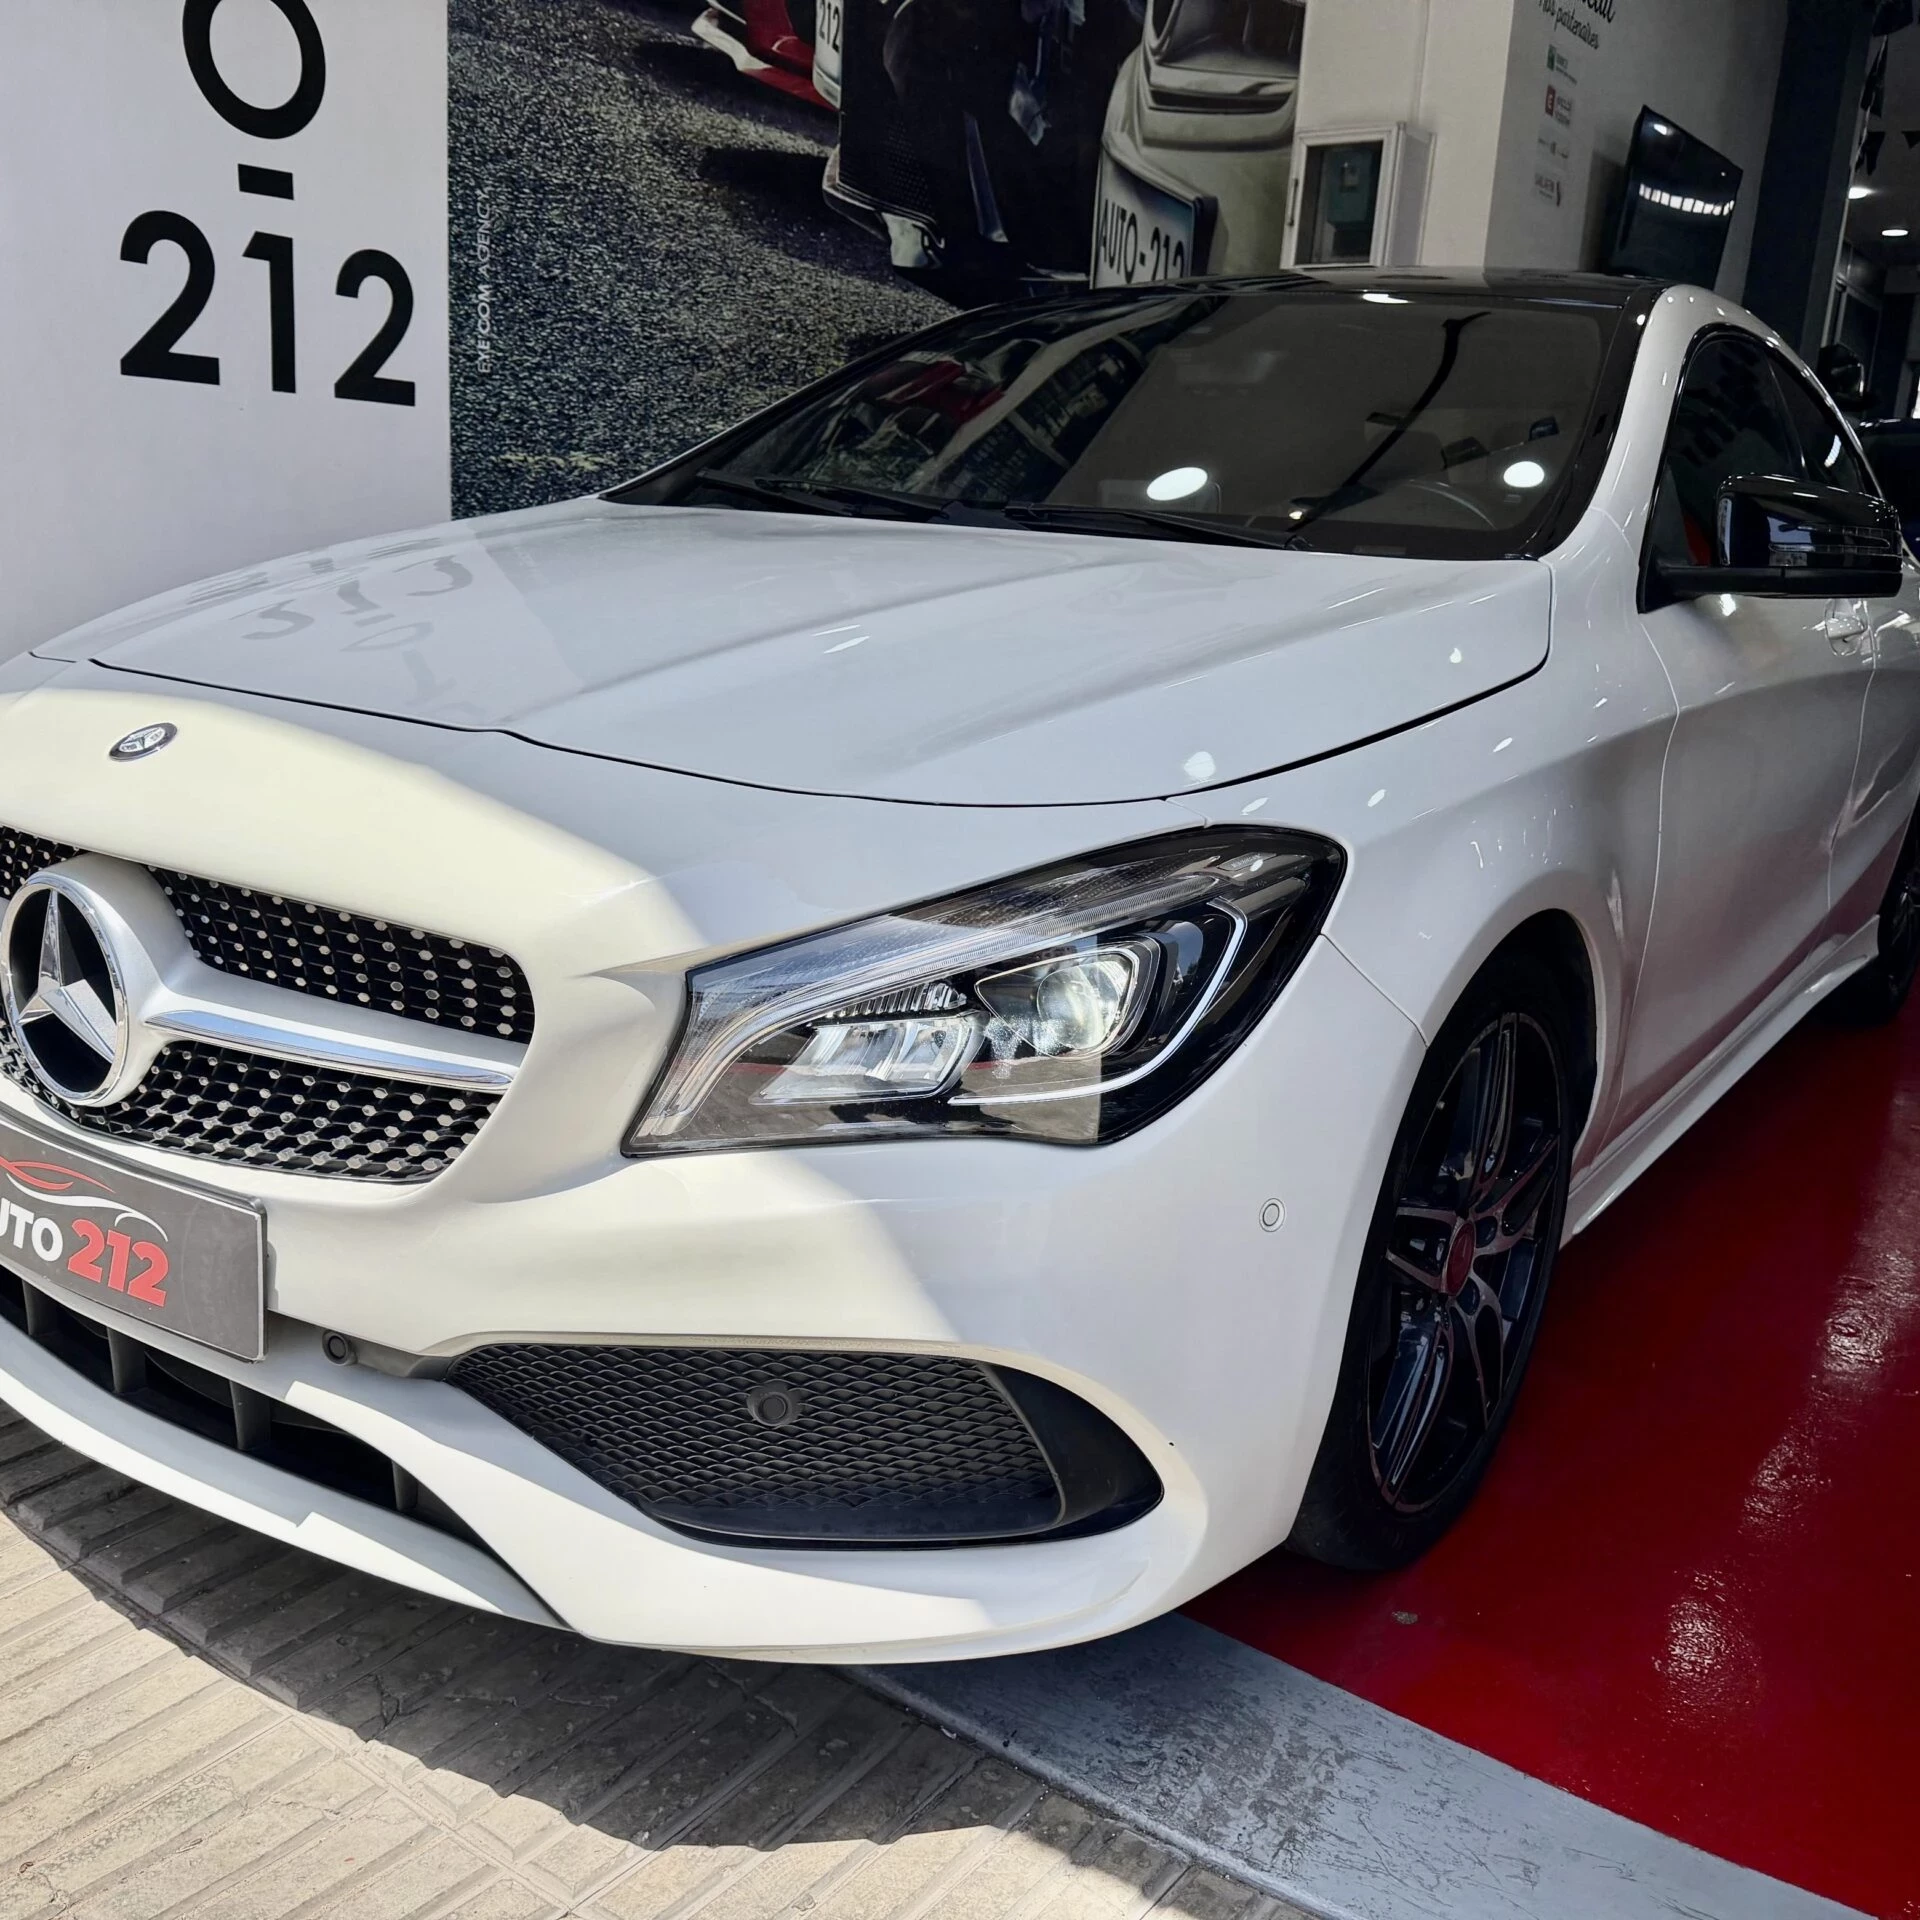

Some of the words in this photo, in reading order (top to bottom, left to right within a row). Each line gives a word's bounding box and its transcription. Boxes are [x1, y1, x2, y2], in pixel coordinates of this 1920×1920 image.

[819, 0, 840, 54] 212
[120, 210, 415, 407] 212
[477, 284, 491, 334] COM
[477, 337, 491, 373] EYE
[67, 1218, 169, 1307] 212
